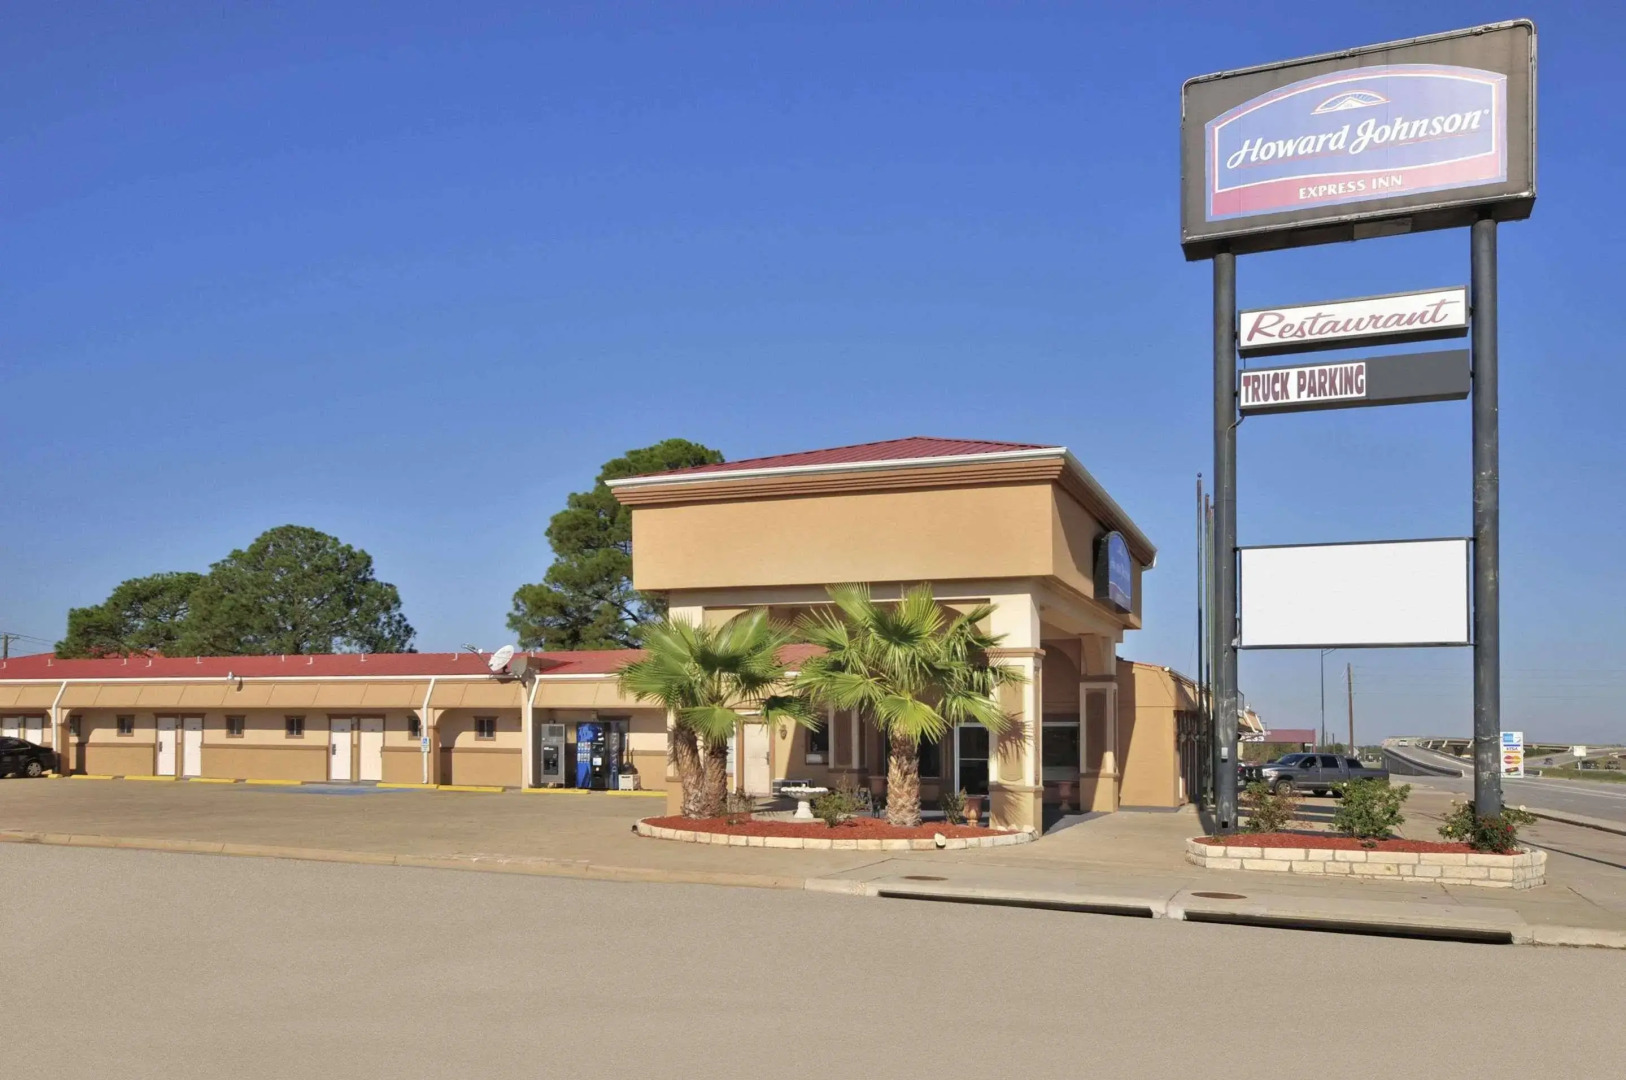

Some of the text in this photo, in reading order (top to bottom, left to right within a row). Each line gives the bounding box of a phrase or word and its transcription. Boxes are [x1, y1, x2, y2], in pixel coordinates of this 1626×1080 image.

[1226, 112, 1481, 169] Howard Johnson
[1299, 175, 1403, 200] EXPRESS INN
[1246, 299, 1460, 342] Restaurant
[1242, 364, 1365, 403] TRUCK PARKING
